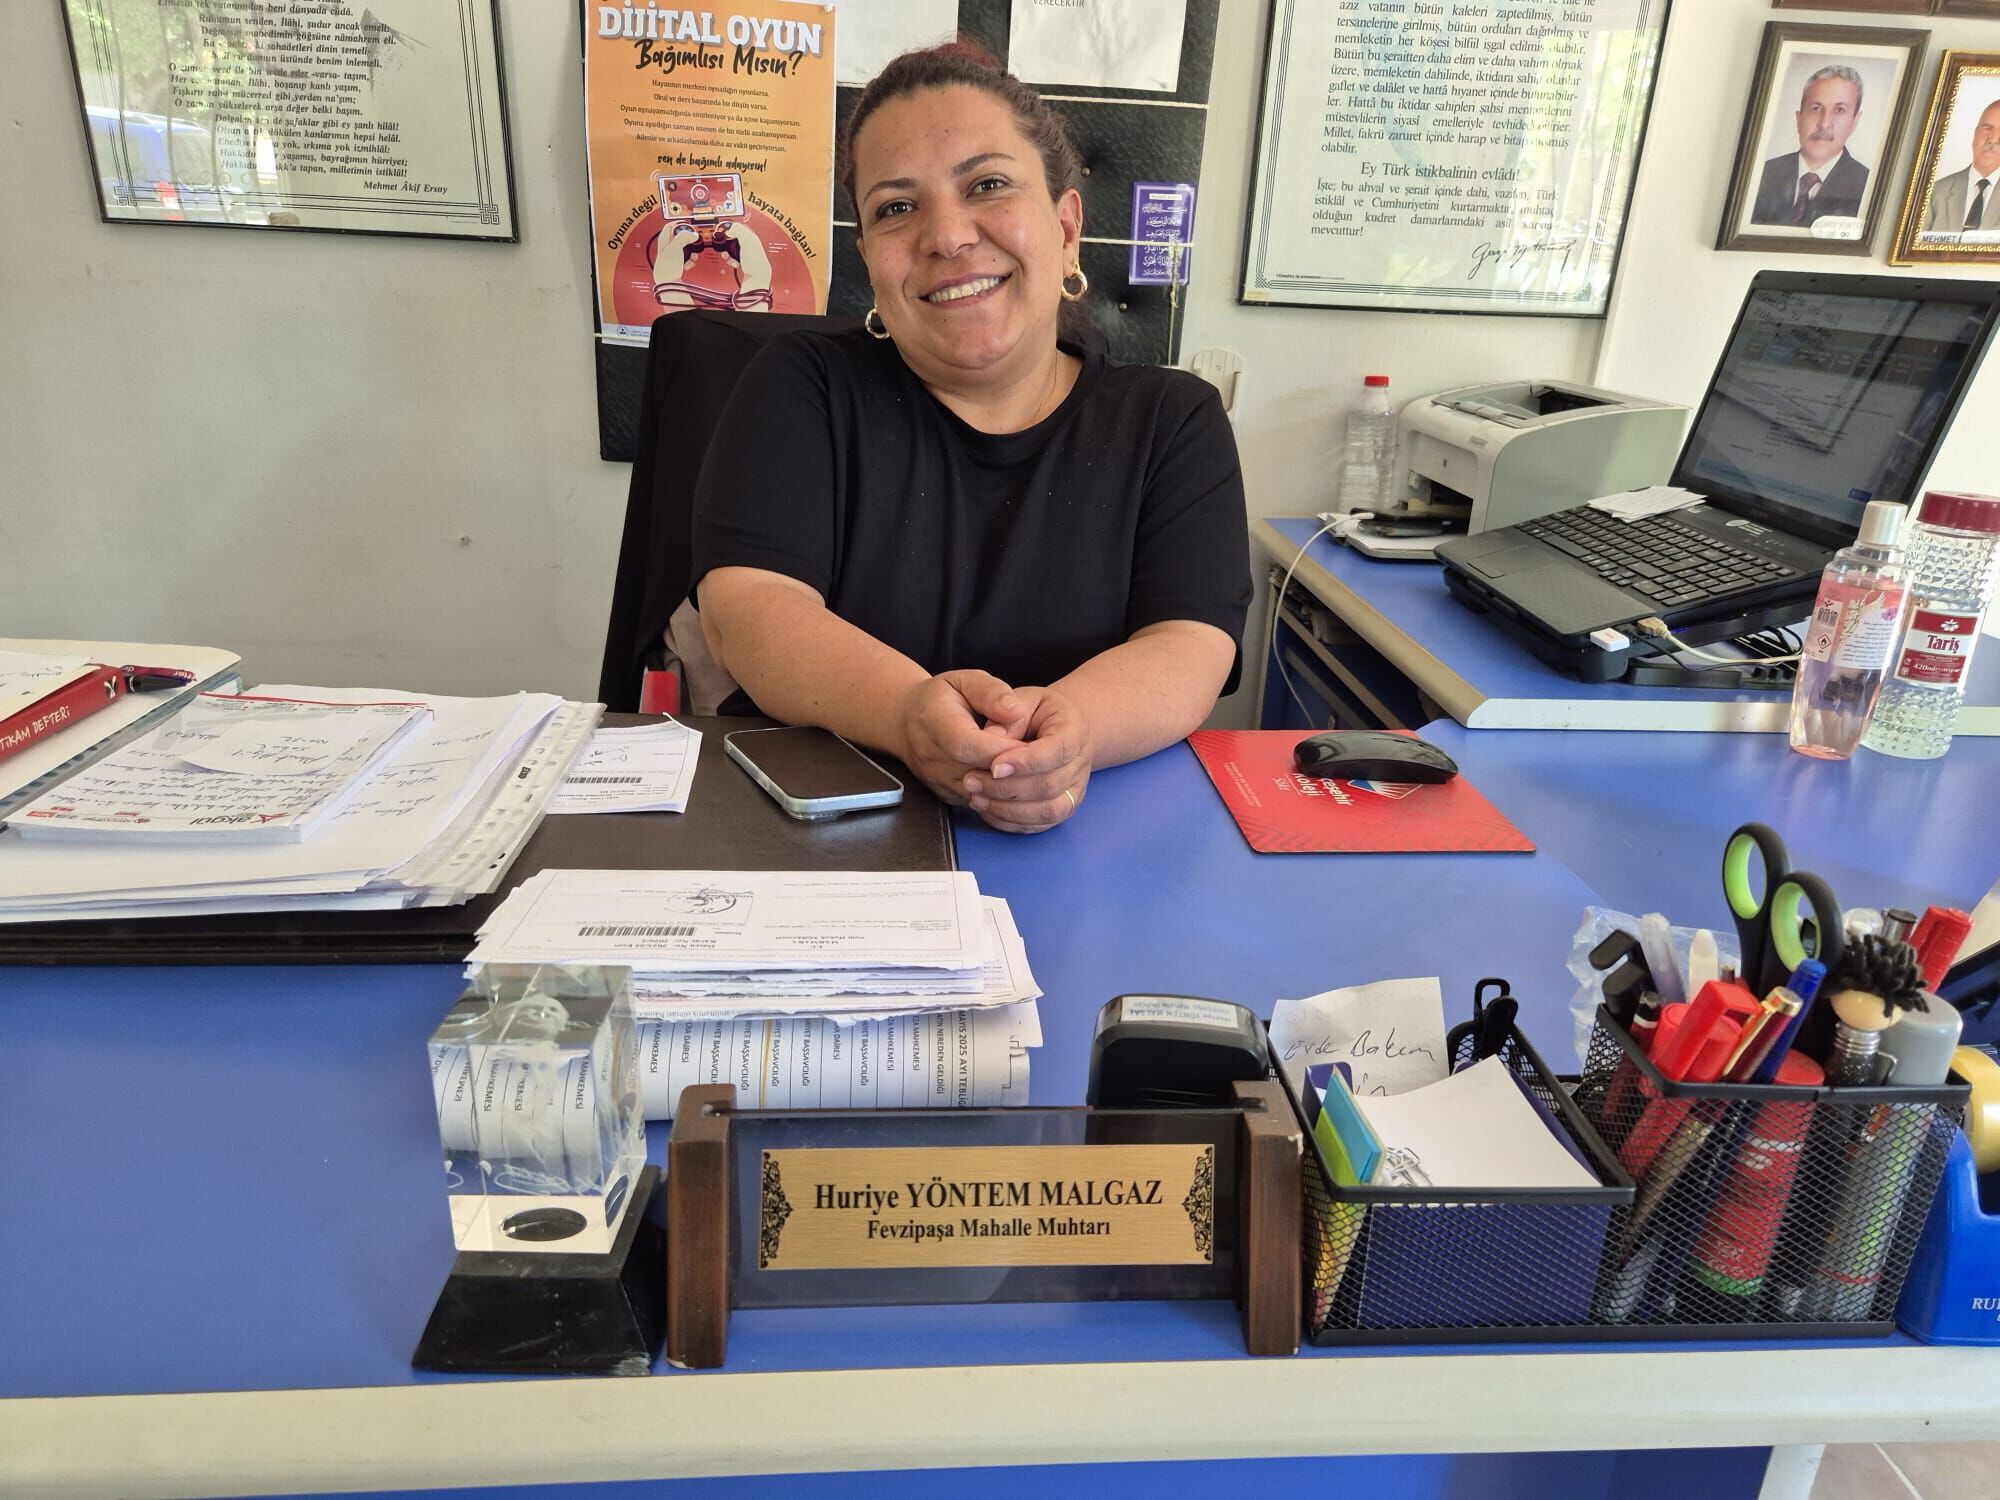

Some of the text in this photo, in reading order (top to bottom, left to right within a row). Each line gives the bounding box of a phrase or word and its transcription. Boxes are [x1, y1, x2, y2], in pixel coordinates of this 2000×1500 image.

[598, 0, 822, 53] DİJİTAL OYUN
[1337, 17, 1398, 29] tersanelerine
[1447, 21, 1477, 33] bütün
[1481, 24, 1521, 35] orduları
[634, 39, 803, 77] Bağımlısı Mısın?
[1334, 48, 1364, 60] Bütün
[1367, 49, 1380, 60] bu
[1427, 52, 1451, 64] daha
[1454, 53, 1475, 65] elim
[1478, 57, 1489, 65] ve
[1491, 55, 1516, 66] daha
[1519, 57, 1549, 68] vahim
[1552, 58, 1583, 70] olmak
[708, 86, 737, 94] oynadığın
[1328, 80, 1355, 93] gaflet
[1360, 83, 1370, 92] ve
[1409, 86, 1420, 95] ve
[1490, 86, 1519, 100] içinde
[313, 105, 332, 114] belki
[1348, 96, 1376, 108] Hattâ
[1380, 98, 1394, 109] bu
[1398, 98, 1431, 110] iktidar
[273, 116, 283, 124] de
[285, 117, 320, 128] şafaklar
[323, 120, 338, 128] gibi
[624, 119, 643, 127] Oyuna
[305, 130, 350, 140] kanlarımın
[354, 132, 375, 142] hepsi
[1323, 126, 1354, 139] Millet,
[1388, 131, 1422, 142] zaruret
[1426, 132, 1454, 144] içinde
[1458, 133, 1486, 146] harap
[1490, 136, 1501, 145] ve
[321, 154, 368, 165] bayrağımın
[658, 152, 767, 173] sen de bağımlı adayısın!
[1360, 161, 1377, 177] Ey
[1382, 162, 1410, 176] Türk
[1415, 163, 1477, 179] istikbalinin
[330, 165, 372, 176] milletimin
[364, 180, 447, 195] Mehmet Âkif Ersoy
[1371, 197, 1440, 211] Cumhuriyetini
[608, 194, 658, 249] Oyuna değil
[748, 191, 816, 259] hayata bağlan!
[1312, 210, 1485, 228] olduğun kudret damarlarındaki
[1311, 226, 1364, 236] mevcuttur!
[1922, 235, 1957, 243] MEHMET
[1927, 634, 1960, 654] Tariş
[1318, 778, 1354, 805] çeşehir
[650, 1030, 660, 1073] MAHKEMESİ
[682, 1035, 691, 1063] DAİRESİ
[833, 1034, 841, 1060] DAİRESİ
[887, 1027, 895, 1071] MAHKEMESİ
[912, 1027, 920, 1071] MAHKEMESİ
[936, 1029, 944, 1062] NEREDEN
[959, 1034, 968, 1056] 2025
[740, 1040, 750, 1091] BAŞSAVCILIĞI
[771, 1039, 780, 1087] BAŞSAVCILIĞI
[802, 1039, 810, 1087] BAŞSAVCILIĞI
[860, 1039, 868, 1086] BAŞSAVCILIĞI
[959, 1058, 968, 1075] AYI
[936, 1064, 945, 1094] GELDİĞİ
[814, 1176, 1163, 1215] Huriye YÖNTEM MALGAZ
[867, 1217, 1110, 1243] Fevzipaşa Mahalle Muhtarı
[1971, 1297, 2000, 1311] RU
